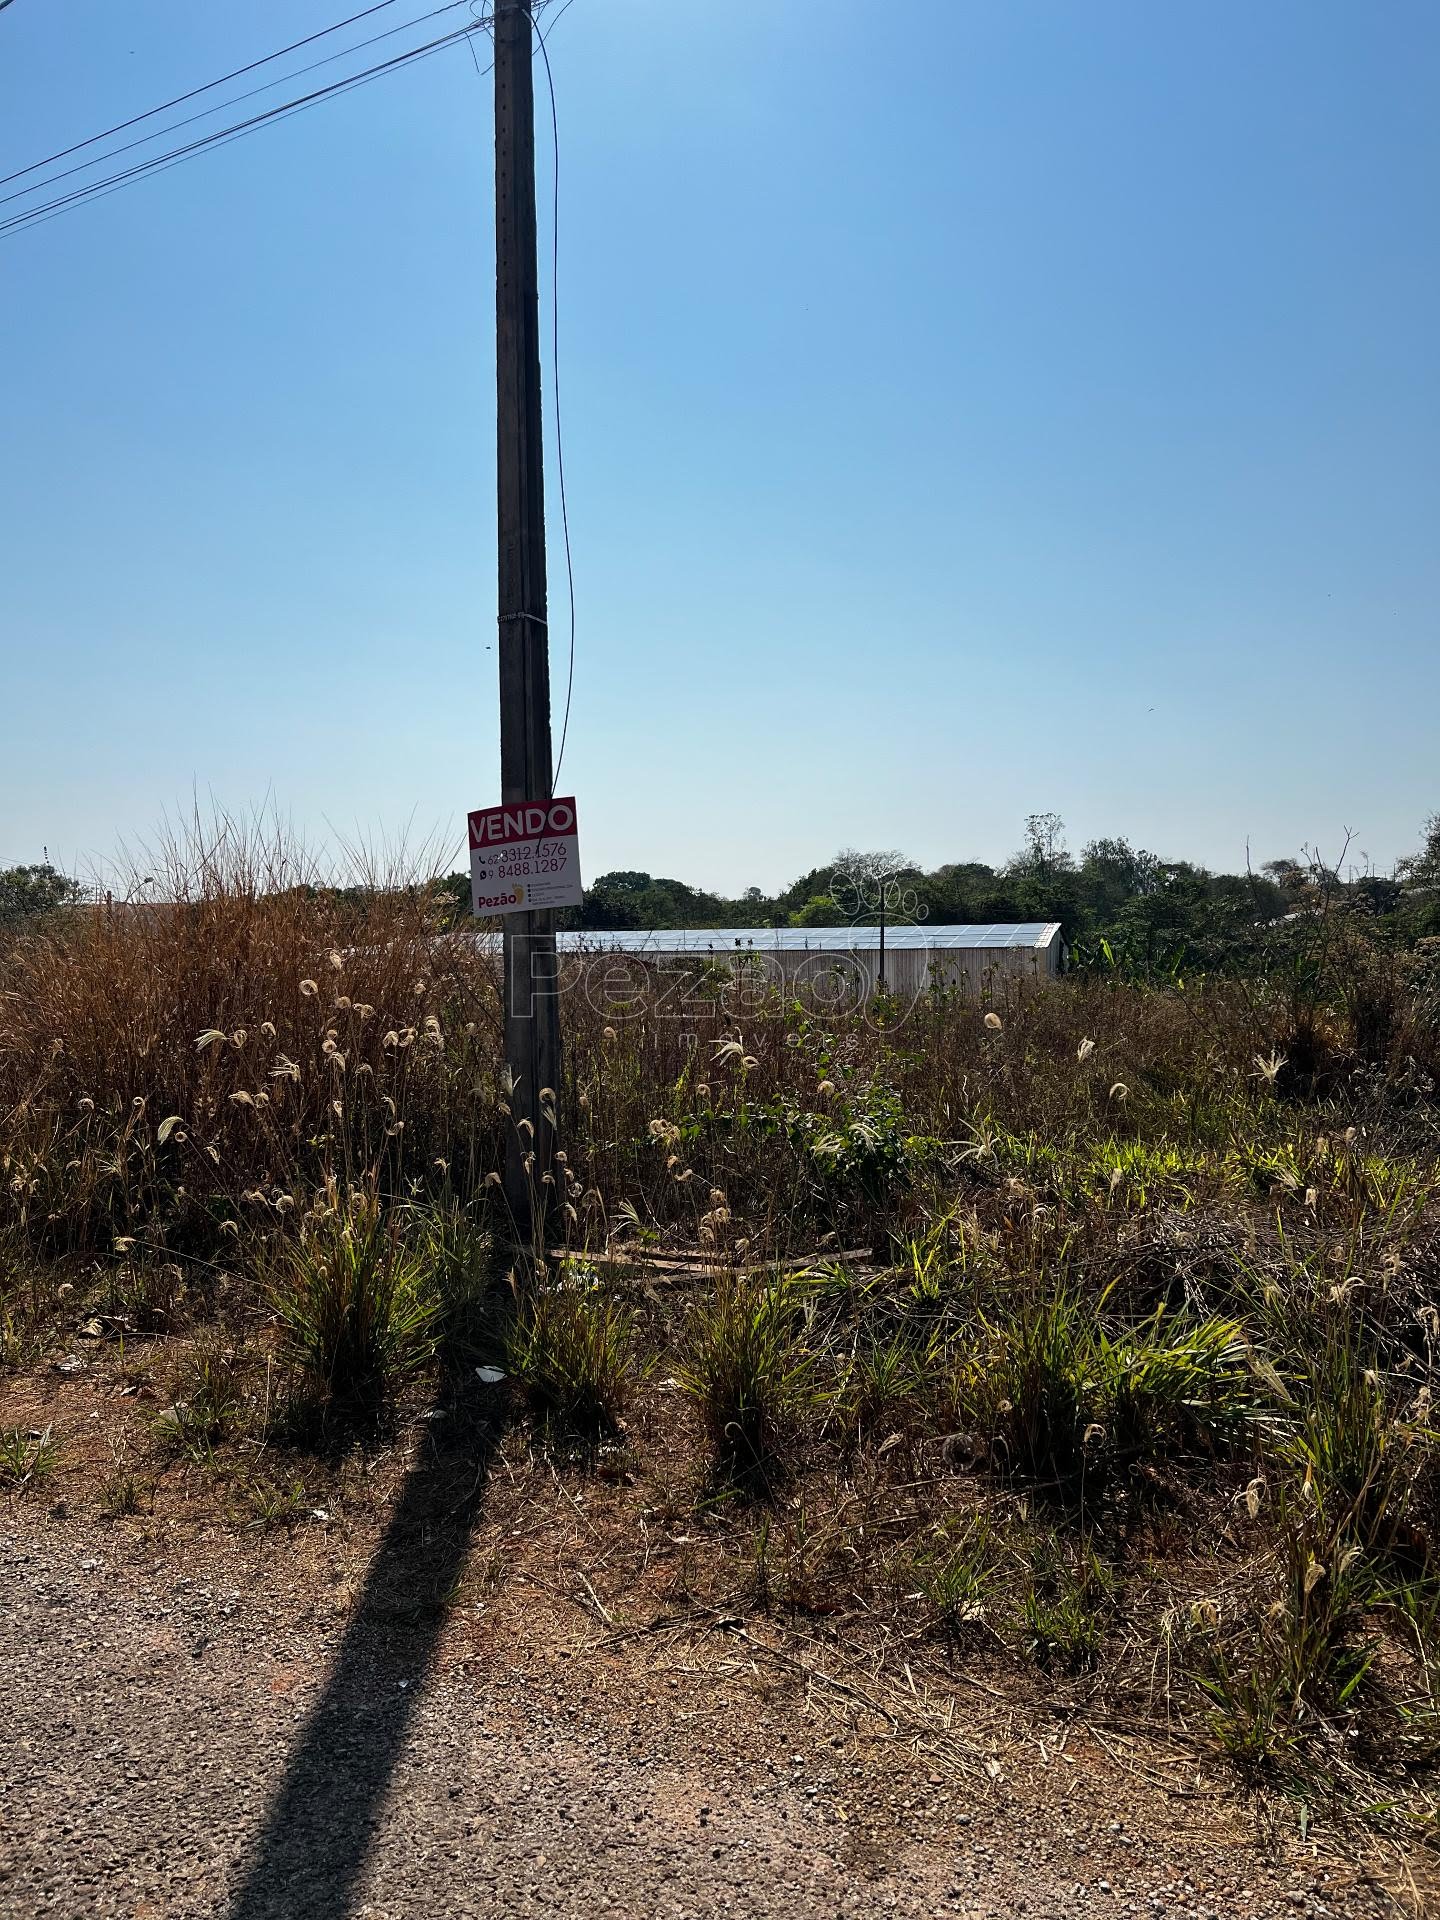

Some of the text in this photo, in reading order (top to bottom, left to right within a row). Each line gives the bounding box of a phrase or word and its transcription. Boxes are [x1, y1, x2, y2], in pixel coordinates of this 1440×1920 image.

[469, 804, 574, 843] VENDO
[487, 854, 499, 865] 62
[498, 857, 567, 878] 8488.1287
[478, 893, 517, 909] Pezão
